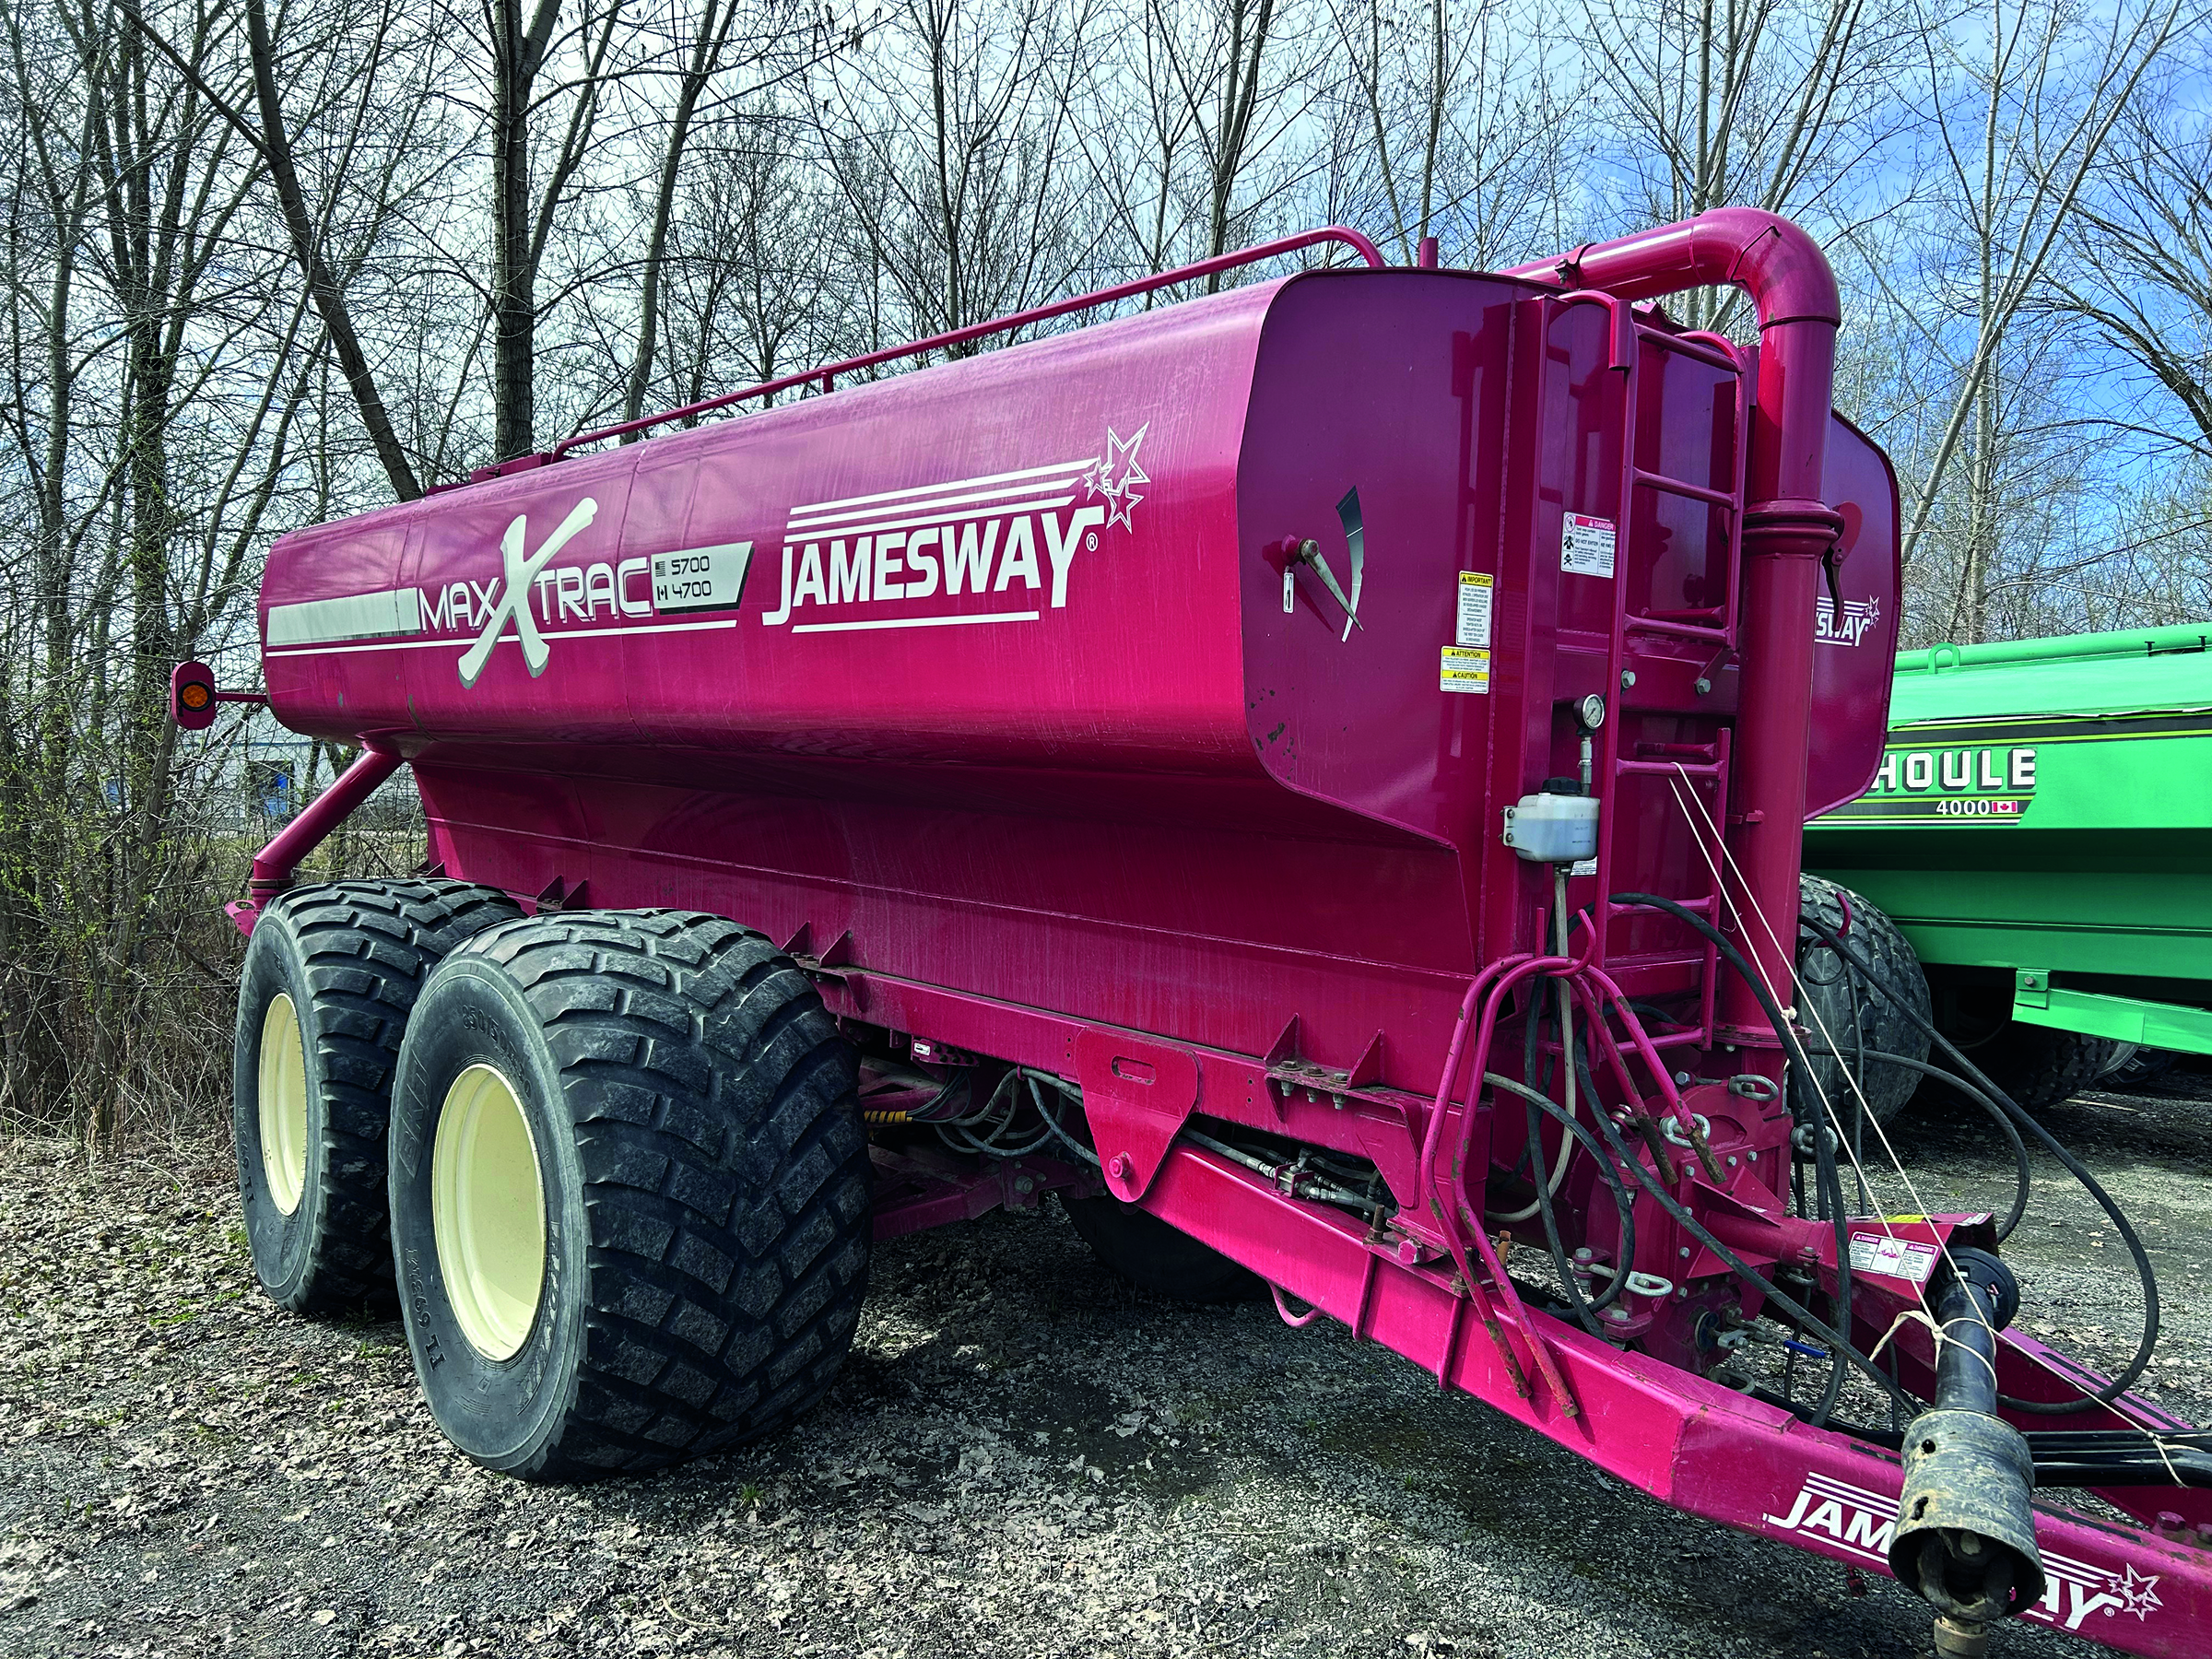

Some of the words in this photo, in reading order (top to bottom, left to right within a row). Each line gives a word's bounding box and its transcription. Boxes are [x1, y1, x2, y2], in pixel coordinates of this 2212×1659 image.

[1594, 521, 1614, 531] DANGER
[671, 555, 710, 575] 5700
[761, 505, 1104, 626] JAMESWAY
[1467, 575, 1491, 584] IMPORTANT
[672, 580, 712, 599] 4700
[1869, 748, 2036, 793] HOULE
[1936, 800, 1990, 815] 4000
